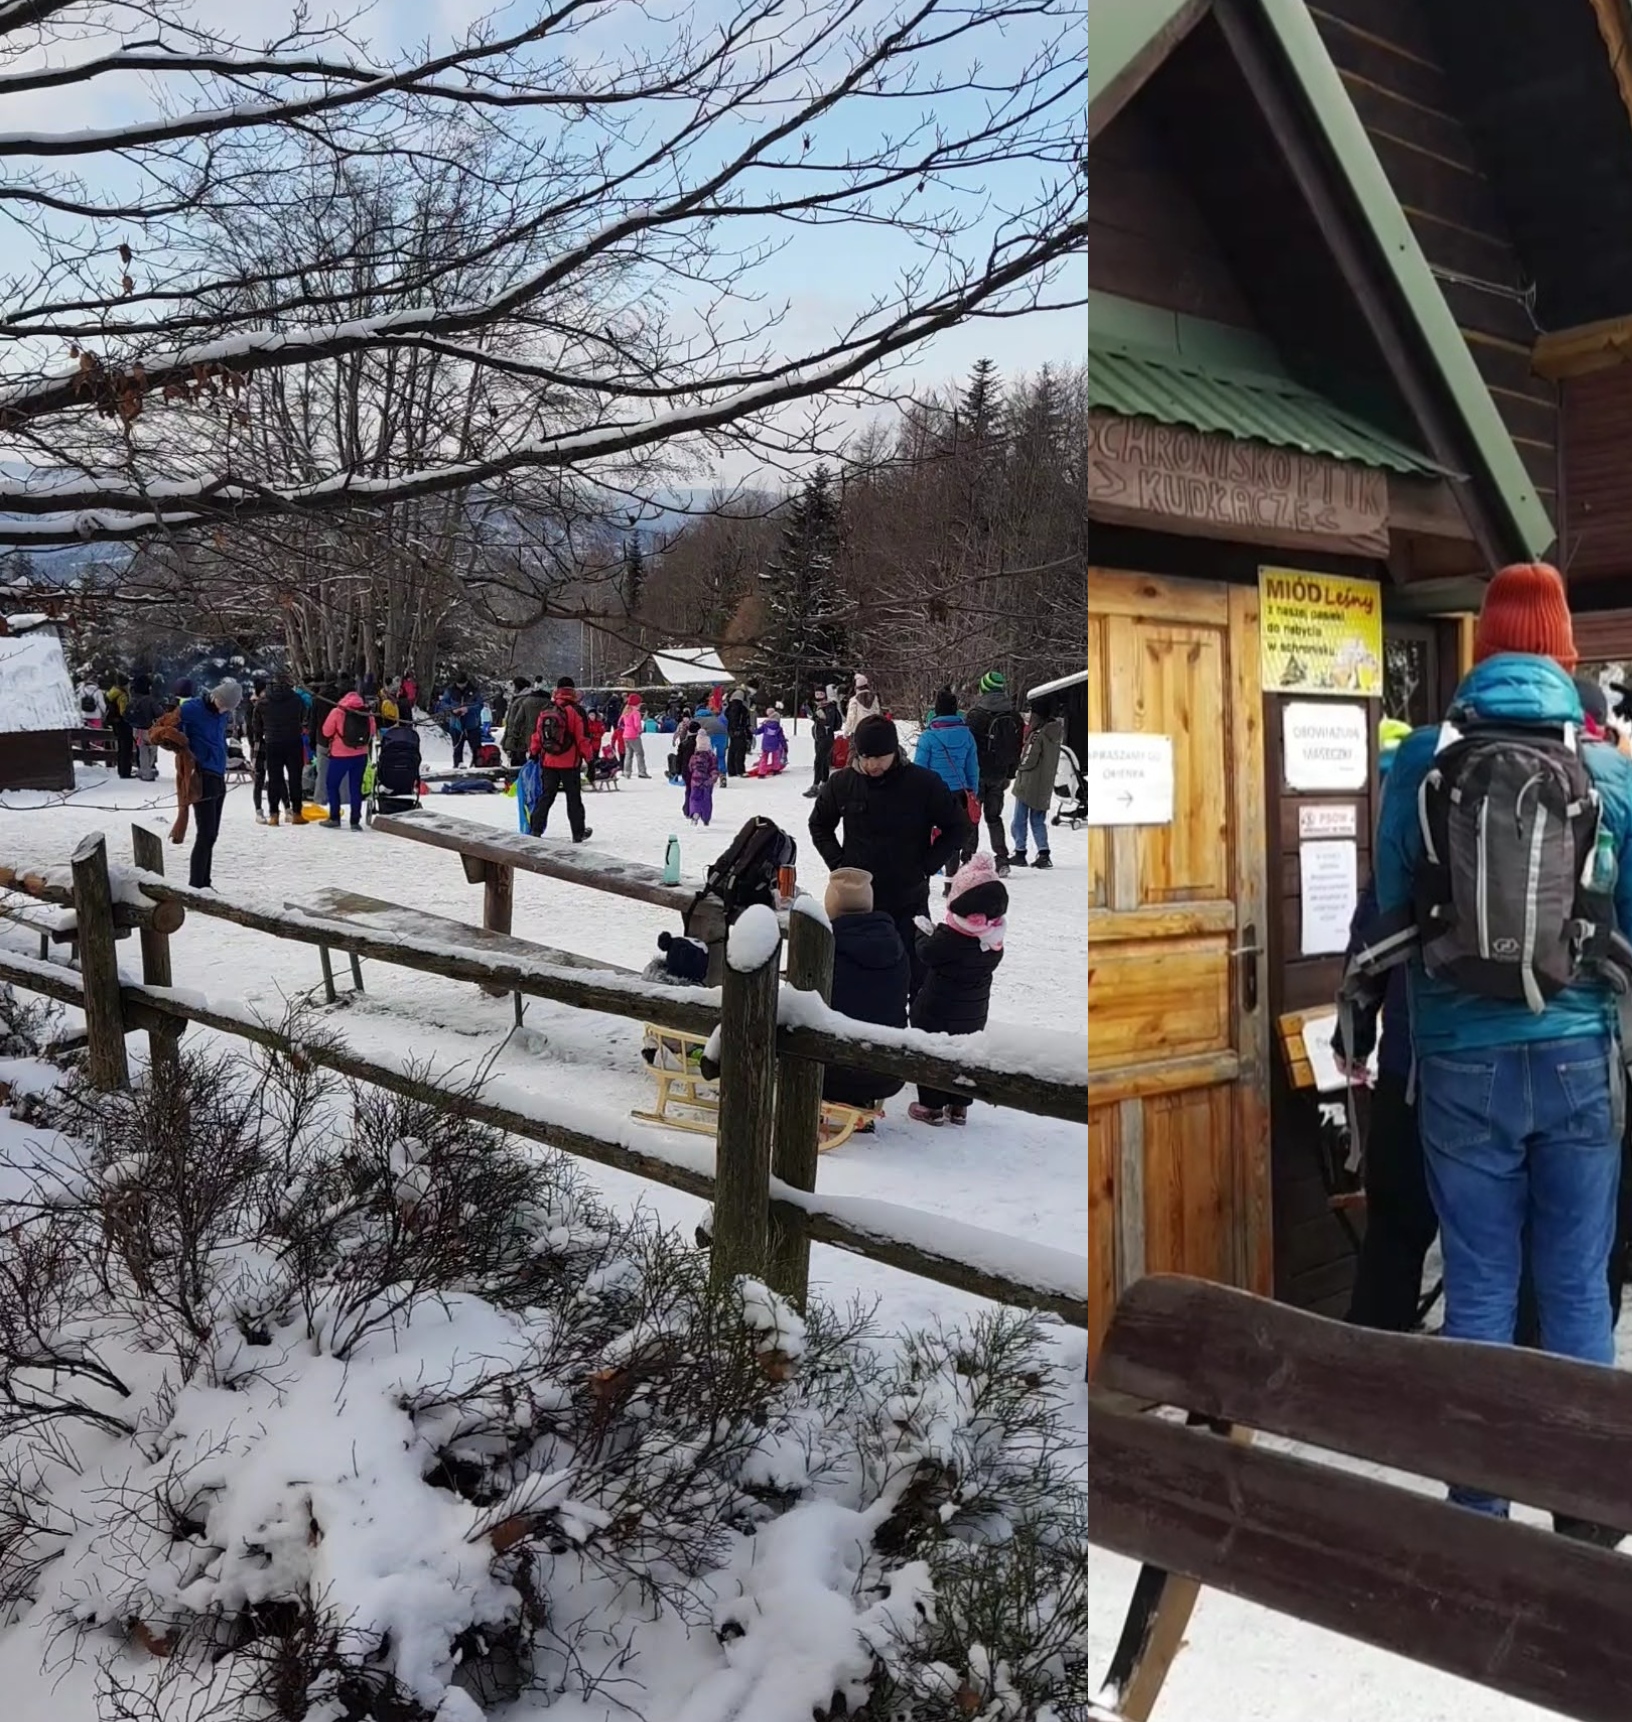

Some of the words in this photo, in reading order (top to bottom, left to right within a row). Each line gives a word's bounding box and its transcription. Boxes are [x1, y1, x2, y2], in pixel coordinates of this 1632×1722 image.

[1138, 469, 1310, 533] KUDŁACZE
[1299, 459, 1380, 516] PTTK
[1266, 576, 1322, 603] MIÓD
[1324, 586, 1374, 615] Leśny
